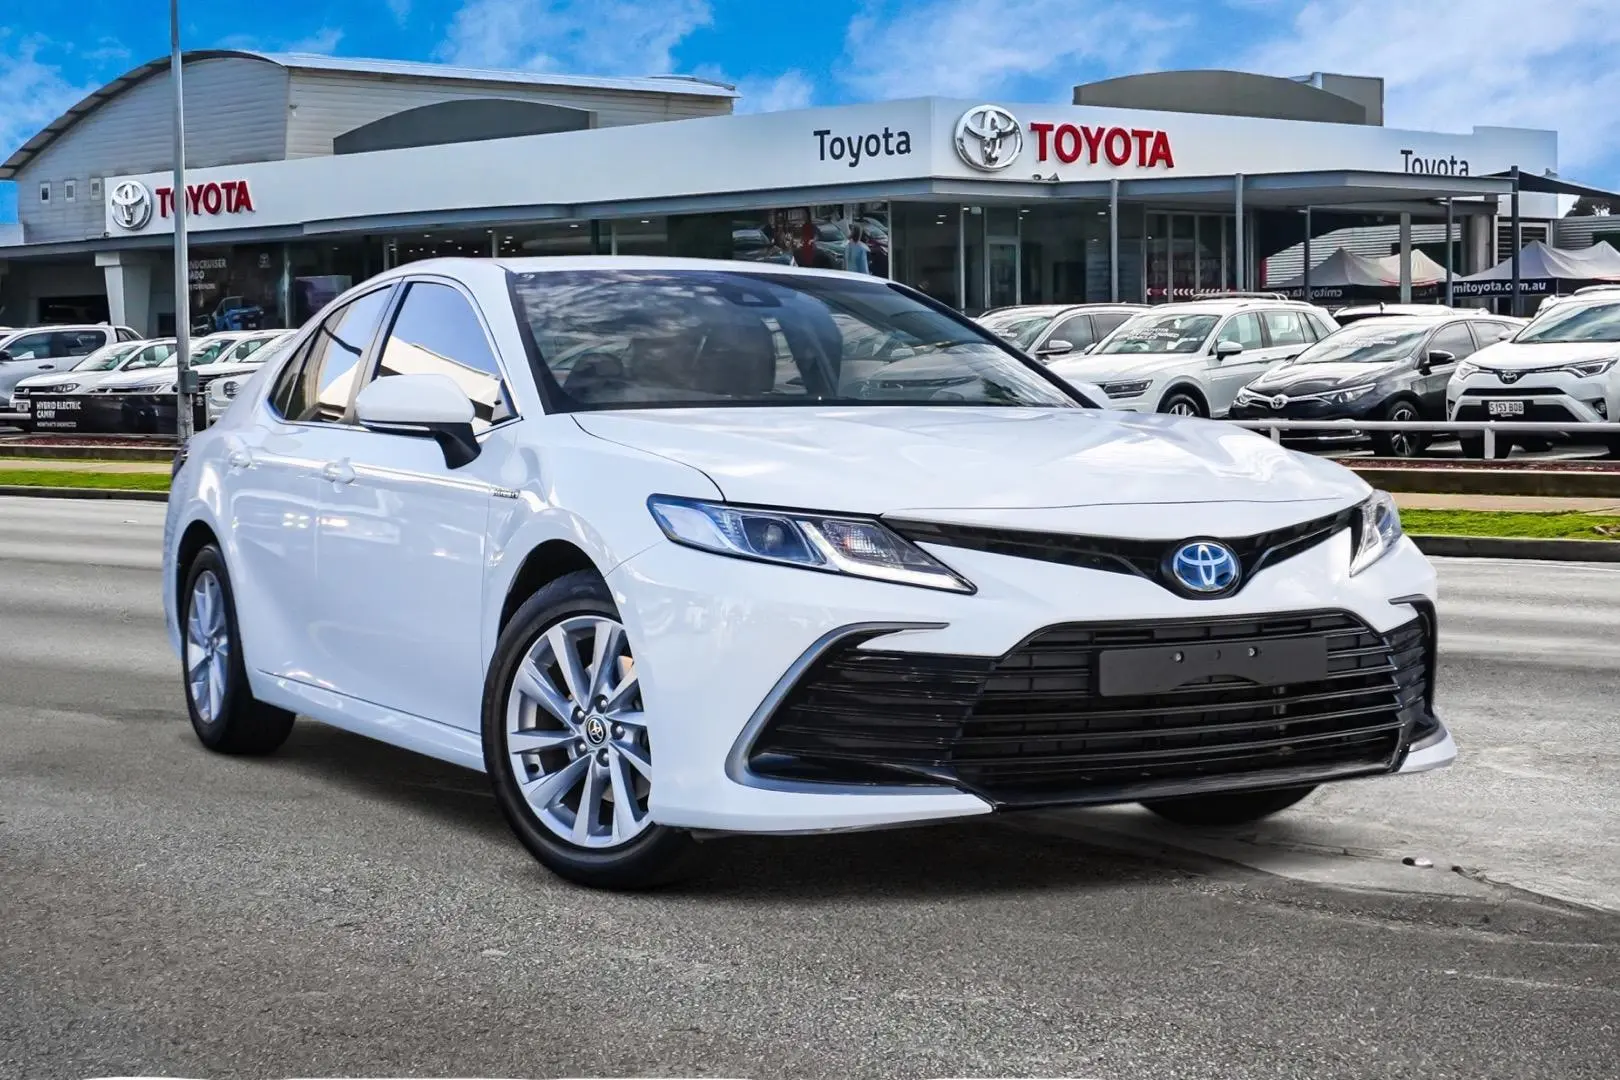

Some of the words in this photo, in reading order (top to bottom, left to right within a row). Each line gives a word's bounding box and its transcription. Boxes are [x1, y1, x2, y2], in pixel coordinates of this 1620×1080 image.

[813, 127, 911, 168] Toyota
[1030, 123, 1174, 168] TOYOTA
[1453, 282, 1546, 295] mitoyota.cm.au
